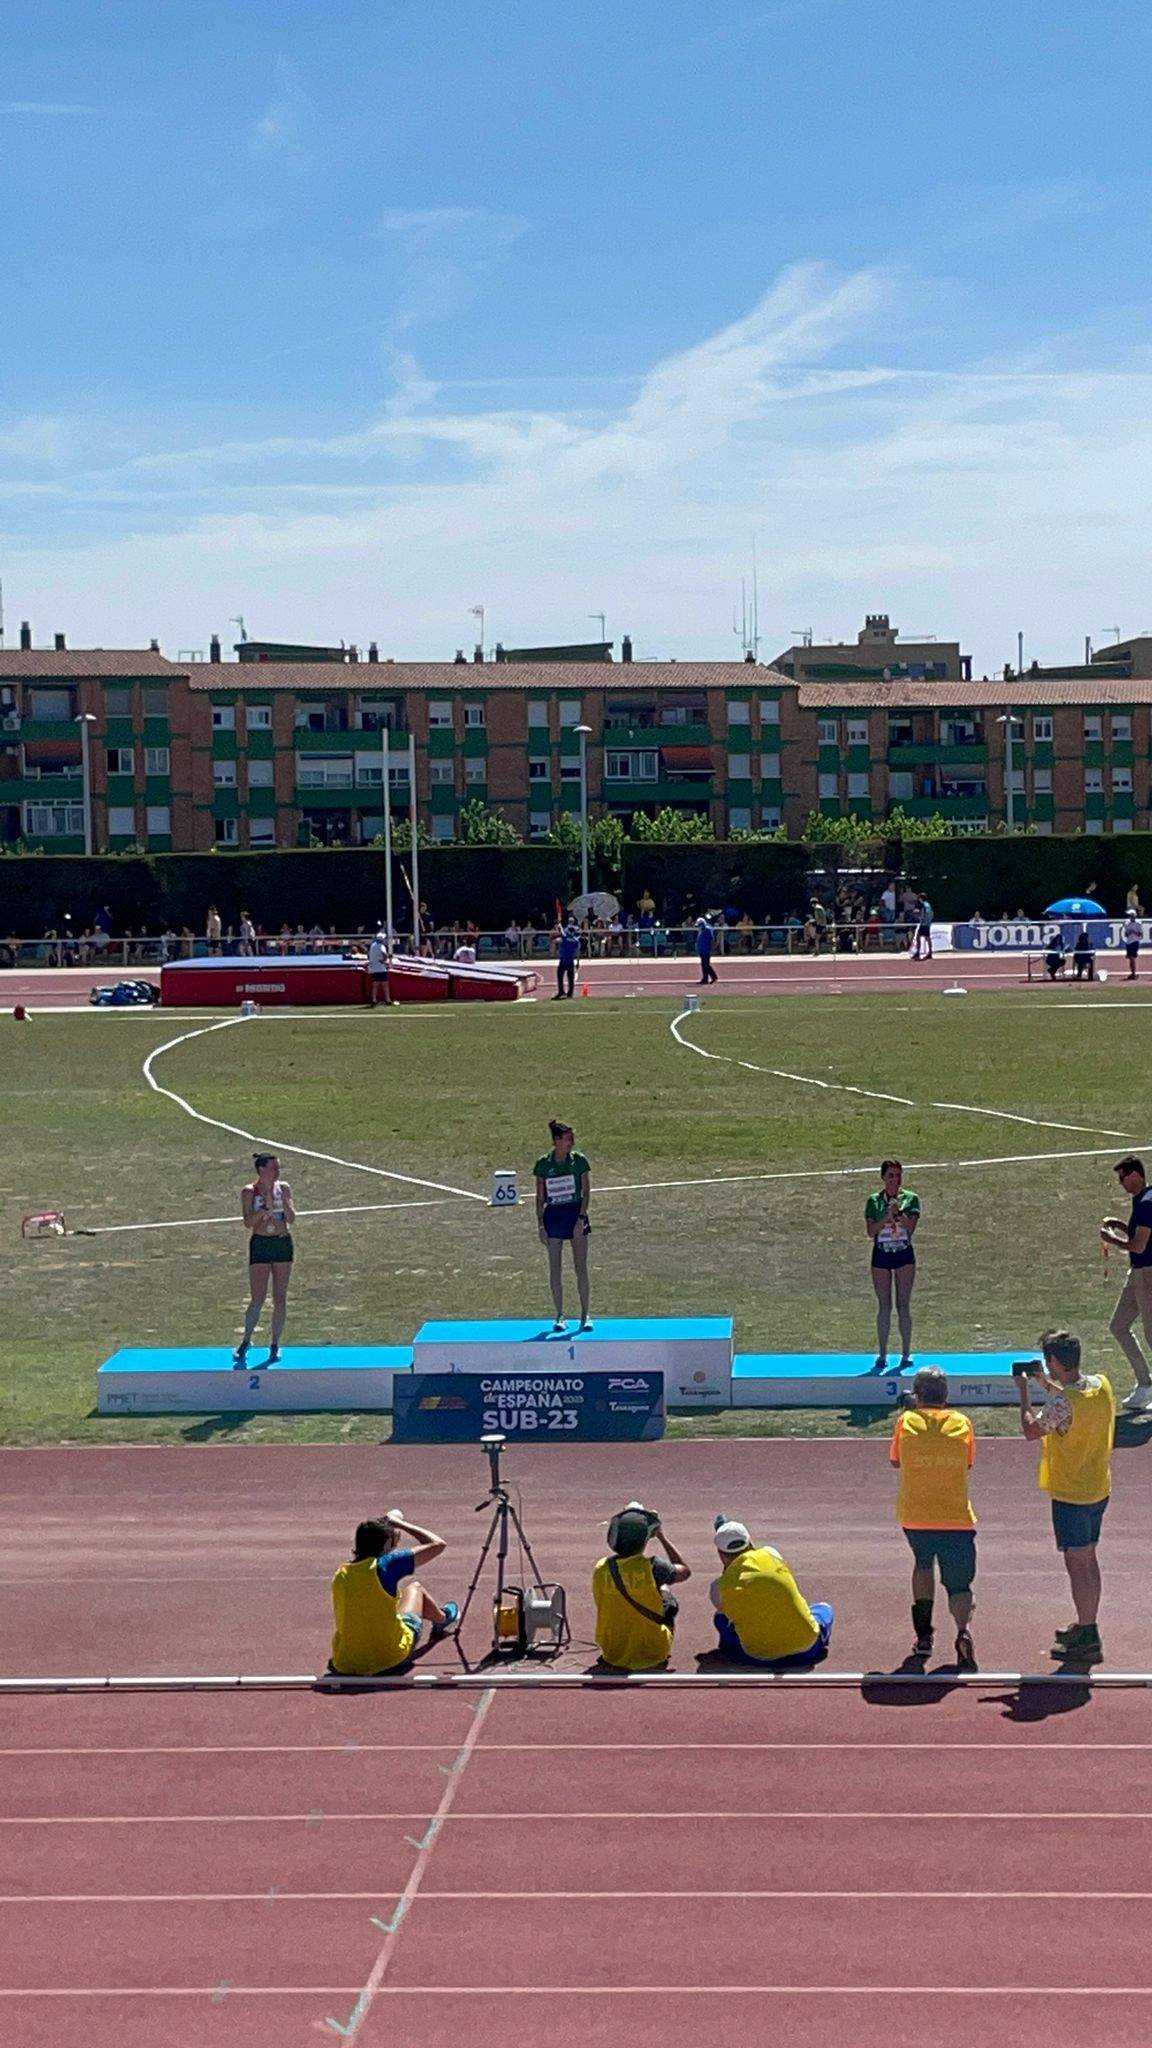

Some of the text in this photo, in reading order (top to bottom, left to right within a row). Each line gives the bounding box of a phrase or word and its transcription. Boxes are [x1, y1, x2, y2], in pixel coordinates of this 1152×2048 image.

[496, 1184, 517, 1200] 65
[567, 1345, 575, 1360] 1
[249, 1375, 260, 1390] 2
[480, 1379, 584, 1391] CAMPEONATO
[886, 1381, 897, 1396] 3
[960, 1384, 992, 1395] PMET
[498, 1391, 563, 1408] ESPAÑA
[482, 1410, 579, 1430] SUB-23
